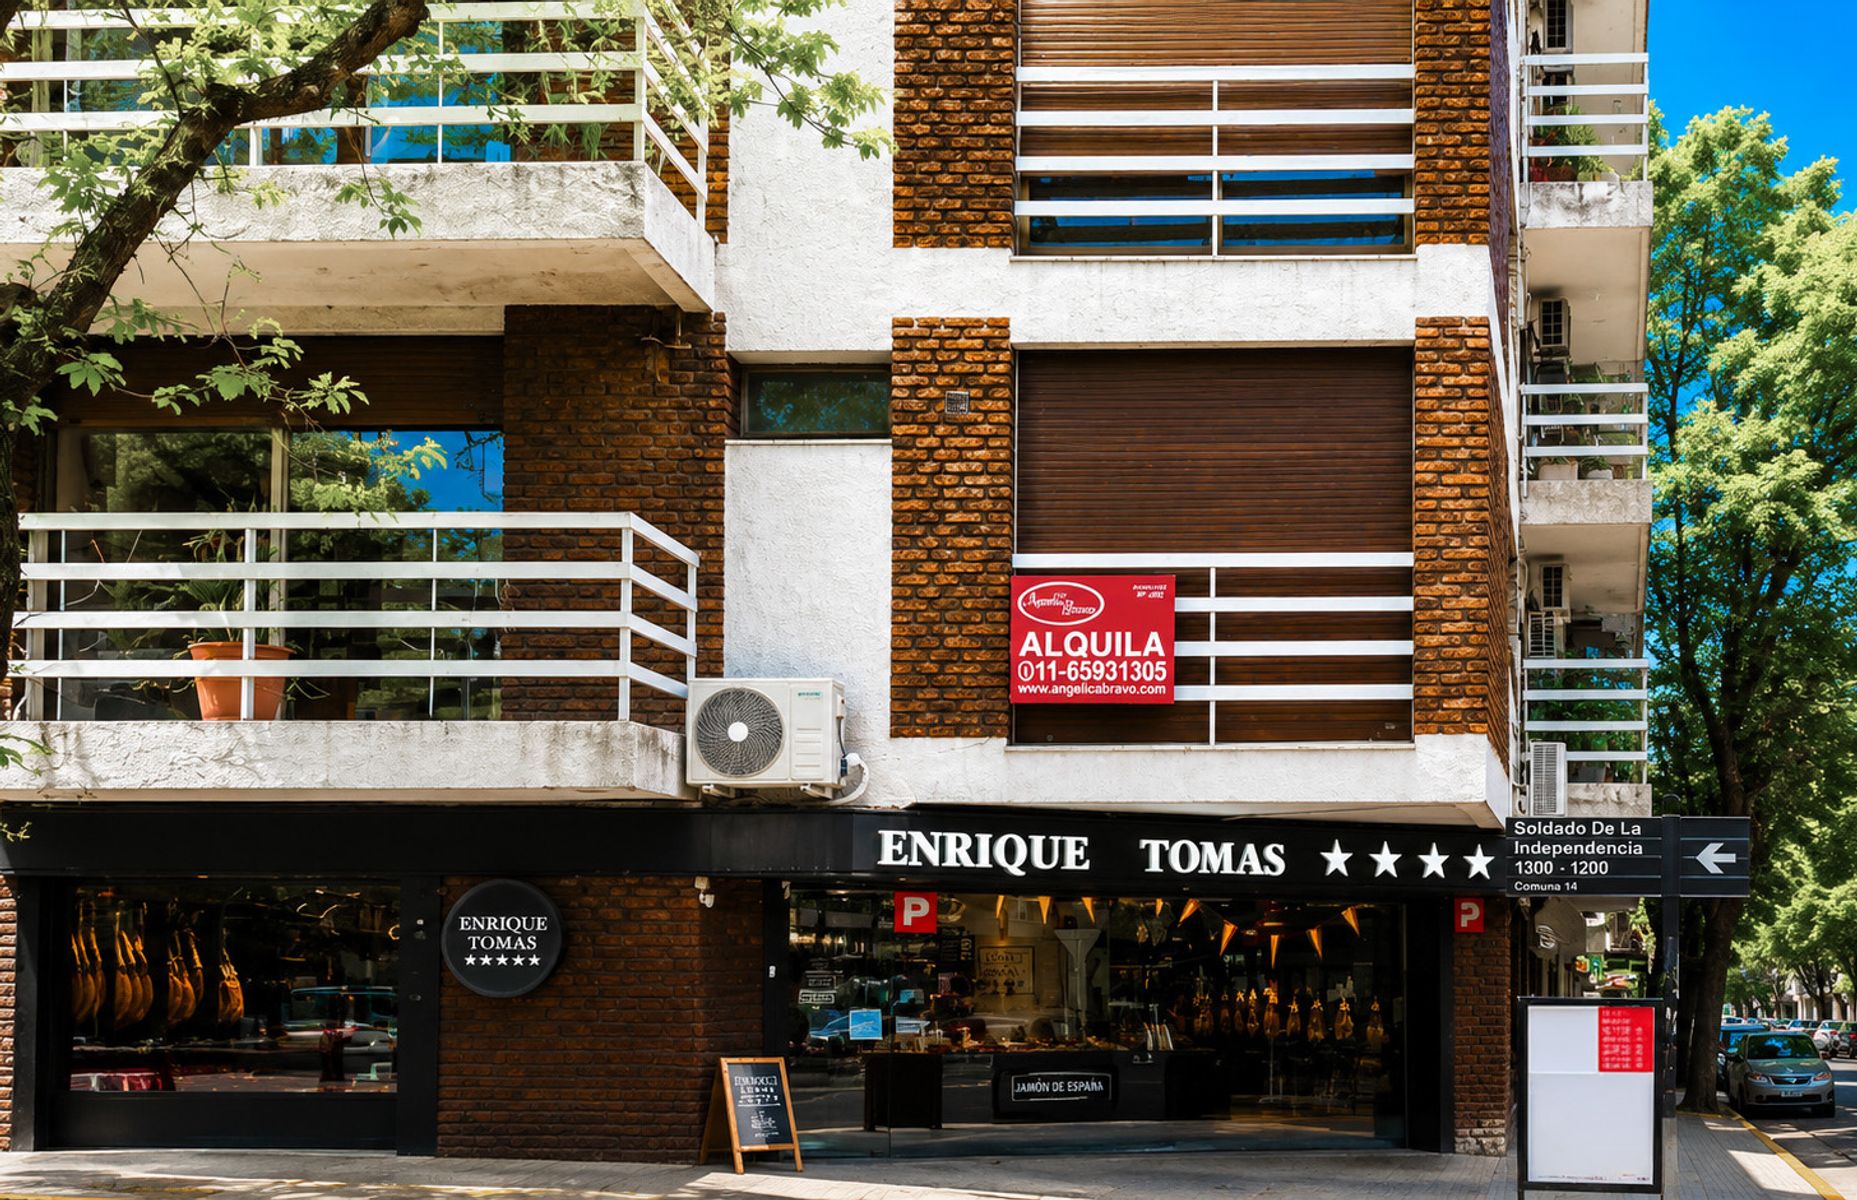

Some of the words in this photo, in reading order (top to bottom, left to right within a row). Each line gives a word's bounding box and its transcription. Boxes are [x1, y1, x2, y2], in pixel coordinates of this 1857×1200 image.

[1019, 631, 1165, 658] ALQUILA
[1018, 683, 1166, 698] www.angelicabravo.com
[1514, 821, 1587, 836] Soldado
[1591, 821, 1615, 836] De
[1622, 821, 1642, 836] La
[877, 830, 1091, 877] ENRIQUE
[1139, 839, 1286, 877] TOMAS
[1514, 841, 1643, 857] Independencia
[1515, 861, 1554, 875] 1300
[1570, 861, 1609, 875] 1200
[1514, 881, 1561, 892] Comuna
[1565, 881, 1578, 892] 14
[903, 897, 930, 926] P
[1460, 902, 1480, 928] P
[458, 916, 548, 934] ENRIQUE
[467, 935, 537, 950] TOMAS
[1052, 1081, 1065, 1092] DE
